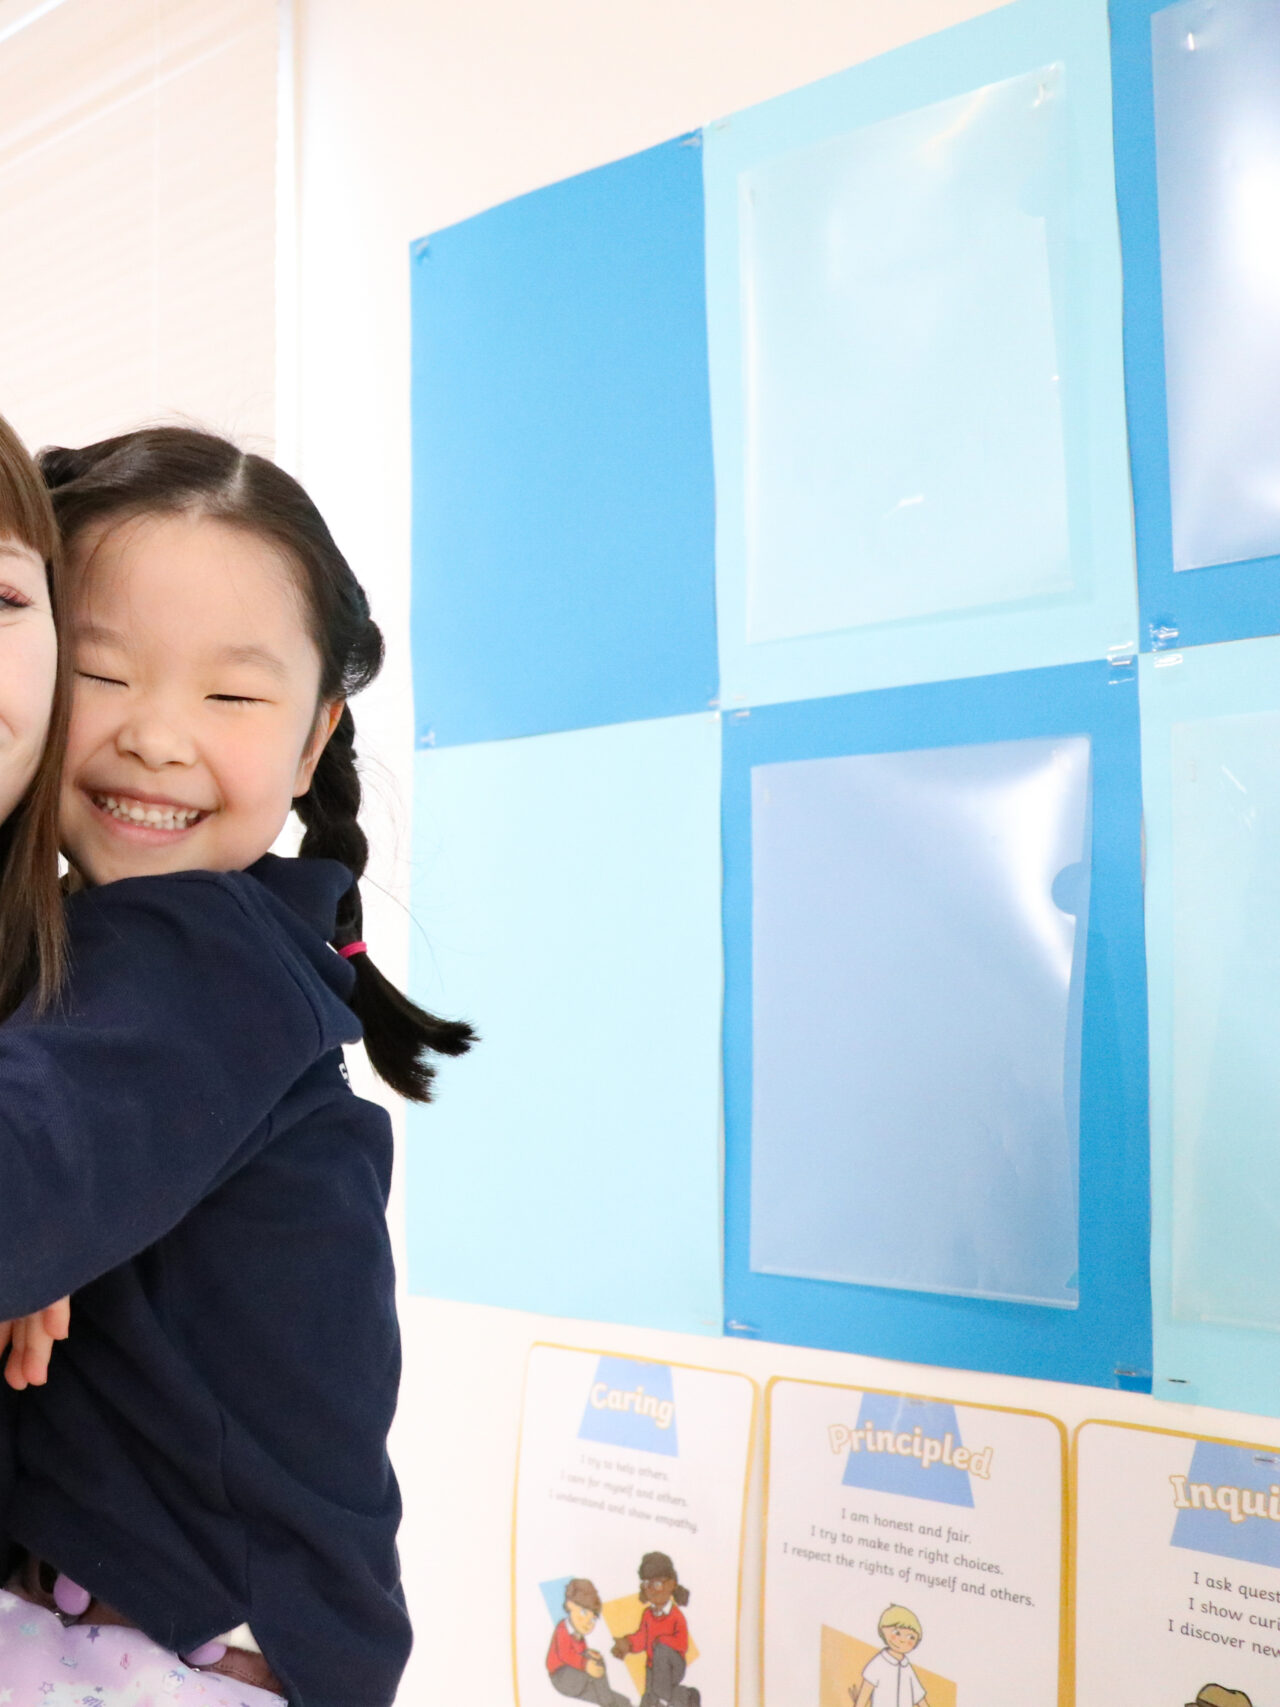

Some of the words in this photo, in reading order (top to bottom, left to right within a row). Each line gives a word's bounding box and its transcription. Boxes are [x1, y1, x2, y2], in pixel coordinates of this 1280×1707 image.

[590, 1382, 675, 1430] Caring
[827, 1420, 994, 1480] Principled
[607, 1504, 625, 1516] and
[636, 1488, 655, 1500] and
[841, 1507, 847, 1520] I
[850, 1512, 870, 1525] am
[874, 1514, 915, 1533] honest
[918, 1525, 942, 1539] and
[946, 1527, 972, 1545] fair.
[810, 1525, 816, 1537] I
[820, 1529, 838, 1545] try
[841, 1533, 854, 1544] to
[858, 1537, 891, 1552] make
[894, 1542, 915, 1557] the
[918, 1547, 950, 1565] right
[953, 1554, 1005, 1576] choices.
[783, 1542, 789, 1555] I
[792, 1546, 832, 1563] respect
[835, 1553, 856, 1568] the
[859, 1559, 895, 1577] rights
[898, 1566, 912, 1584] of
[915, 1572, 957, 1593] myself
[961, 1583, 986, 1597] and
[990, 1588, 1036, 1608] others.
[1194, 1571, 1200, 1585] I
[1206, 1577, 1232, 1592] ask
[1188, 1597, 1194, 1611] I
[1201, 1600, 1244, 1622] show
[1168, 1619, 1174, 1633] I
[1180, 1622, 1246, 1649] discover
